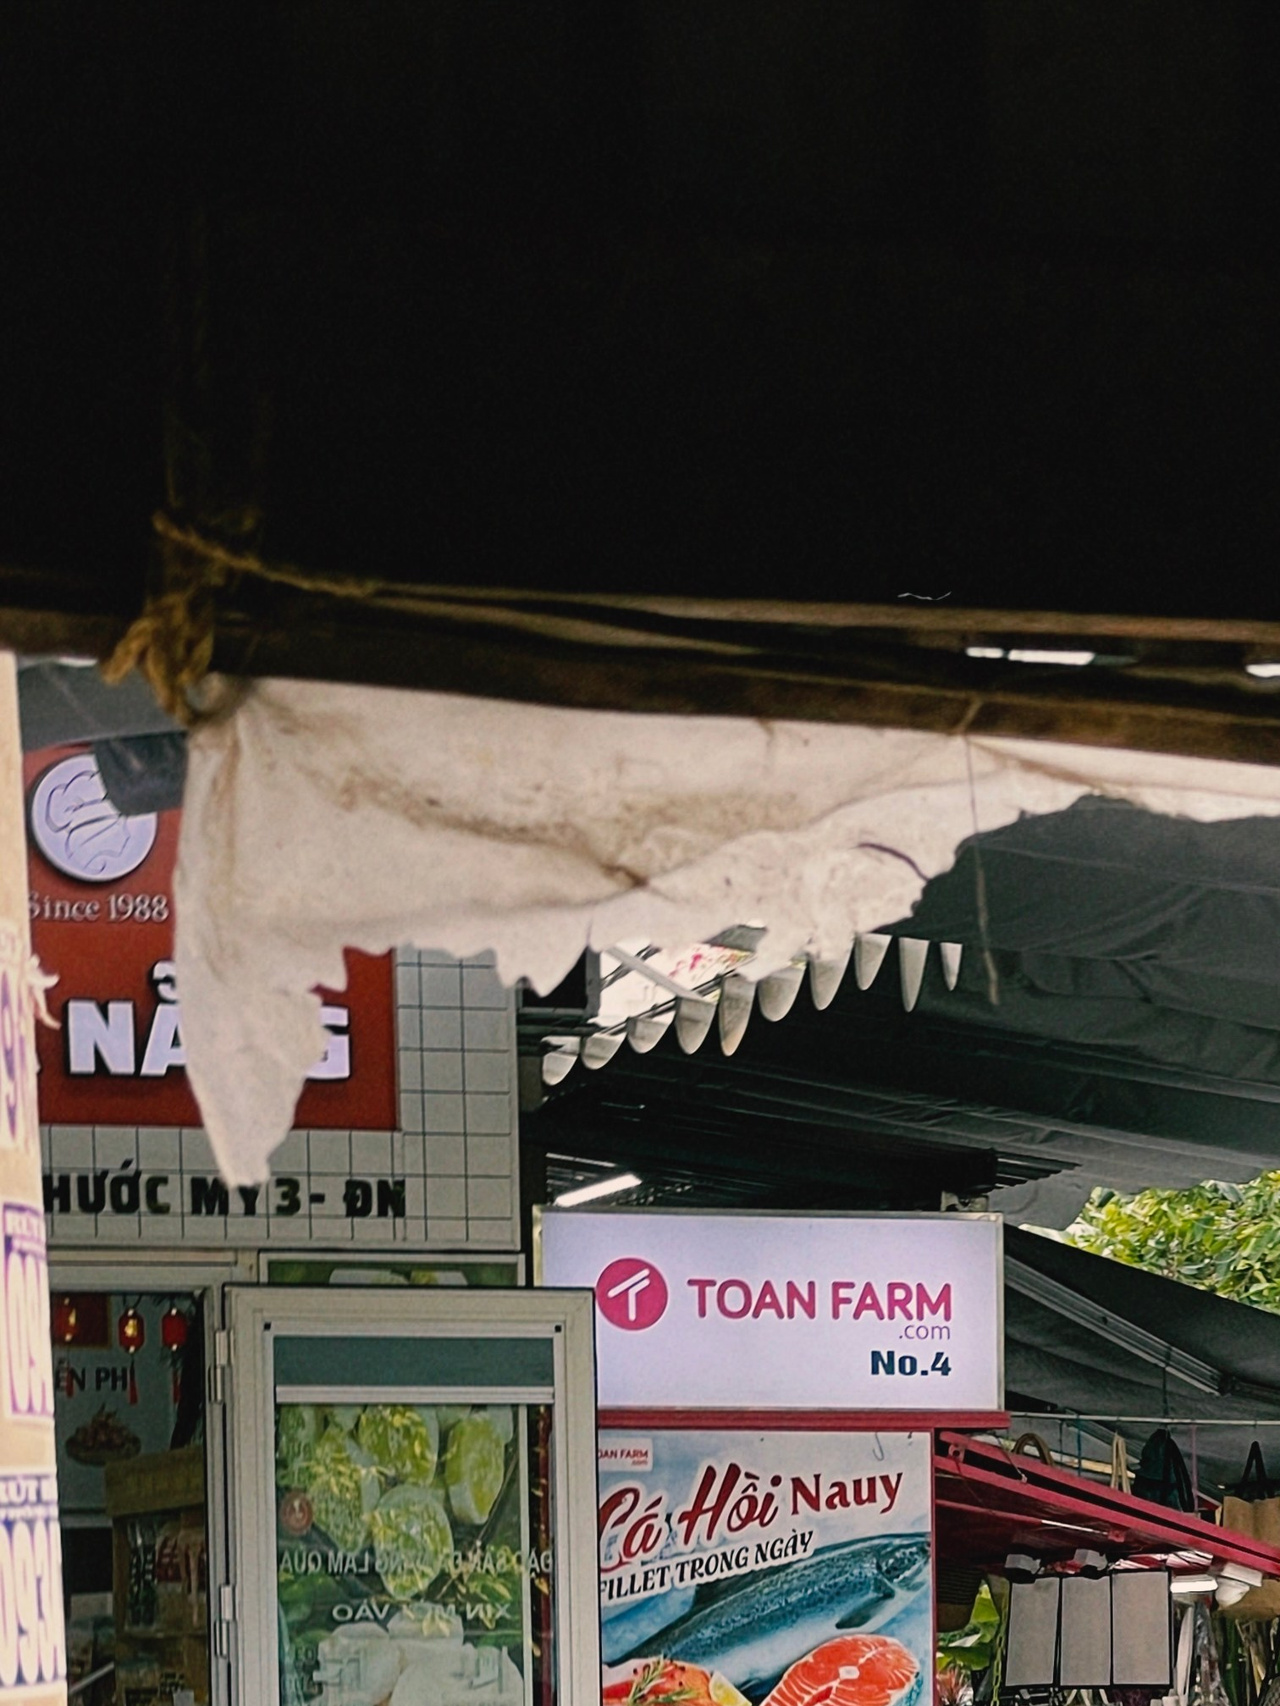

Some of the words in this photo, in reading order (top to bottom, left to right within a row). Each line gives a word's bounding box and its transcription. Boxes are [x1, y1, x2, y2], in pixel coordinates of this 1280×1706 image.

[29, 893, 100, 922] Since
[108, 893, 169, 923] 1988
[343, 1179, 406, 1218] ĐN
[687, 1278, 816, 1321] TOAN
[831, 1280, 952, 1322] FARM
[898, 1324, 951, 1341] .com
[870, 1350, 952, 1378] No.4
[677, 1463, 782, 1546] Hồi
[790, 1471, 904, 1516] Nauy
[674, 1549, 750, 1582] TRONG
[754, 1528, 814, 1566] NGÀY
